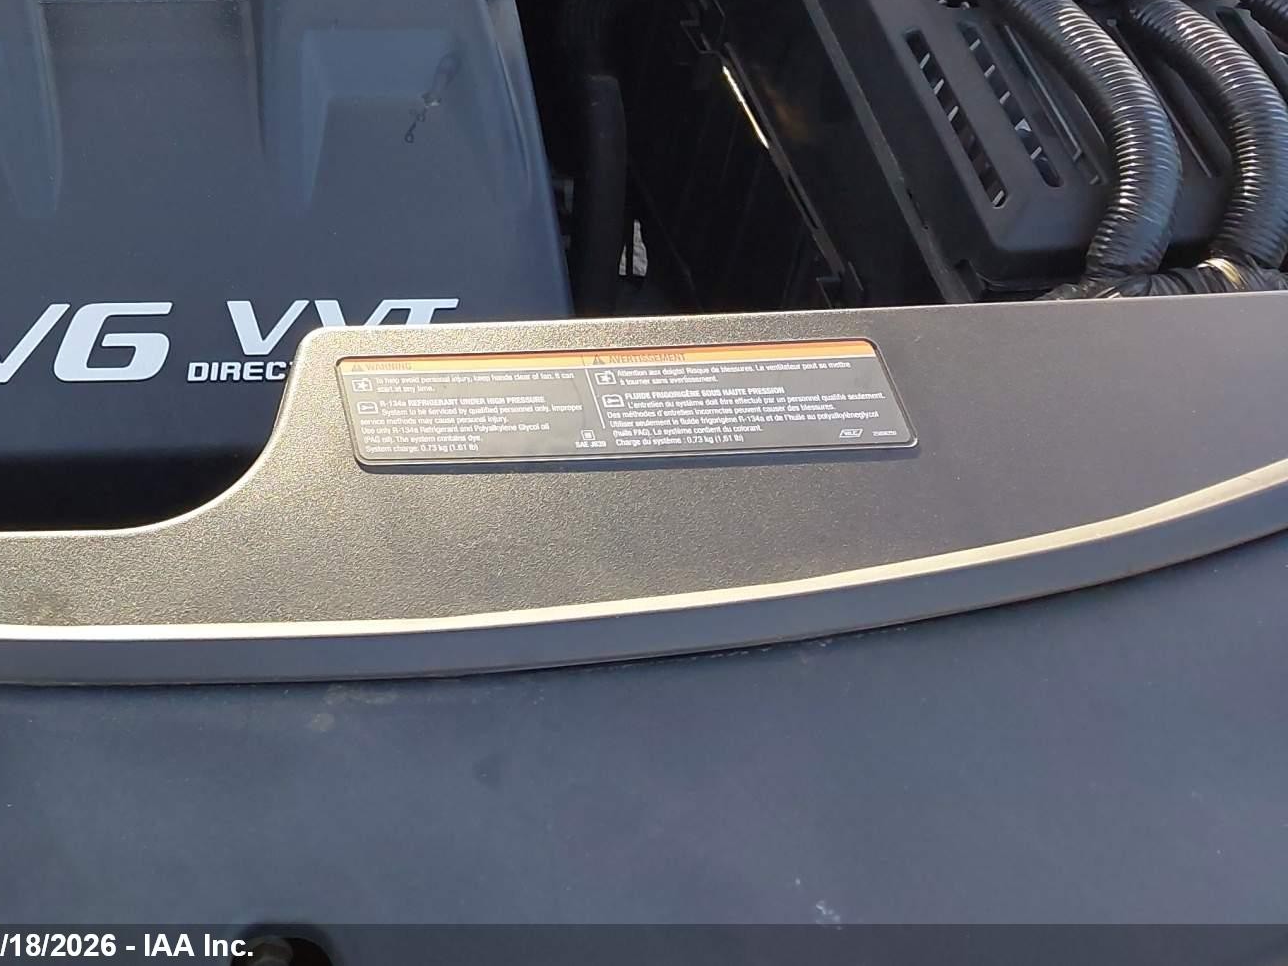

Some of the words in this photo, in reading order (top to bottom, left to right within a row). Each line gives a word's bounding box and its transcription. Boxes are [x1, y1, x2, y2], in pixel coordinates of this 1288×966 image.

[608, 353, 686, 363] AVERTISSEMENT
[187, 361, 293, 381] DIREC
[686, 367, 709, 376] Risque
[421, 375, 450, 384] personal
[652, 389, 700, 398] FRIGORIGÈNE
[748, 387, 785, 395] PRESSION
[408, 398, 458, 406] REFRIGERANT
[628, 400, 663, 408] L'entretien
[676, 399, 704, 408] système
[787, 395, 820, 404] personnel
[382, 408, 408, 417] System
[428, 406, 457, 414] serviced
[458, 406, 467, 414] by
[469, 405, 498, 414] qualified
[500, 404, 532, 413] personnel
[552, 403, 582, 411] Improper
[734, 406, 762, 415] peuvent
[457, 414, 486, 423] personal
[739, 415, 764, 423] R-134a
[376, 427, 390, 435] only
[420, 425, 458, 434] Refrigerant
[518, 422, 539, 431] Glycol
[613, 428, 632, 438] (huile
[663, 427, 692, 436] système
[364, 435, 380, 444] (PAG
[410, 434, 435, 443] system
[616, 438, 641, 447] Charge
[653, 437, 682, 446] système
[704, 436, 713, 444] kg
[734, 435, 744, 443] lb)
[366, 445, 392, 453] System
[440, 443, 448, 451] kg
[468, 442, 479, 450] lb)
